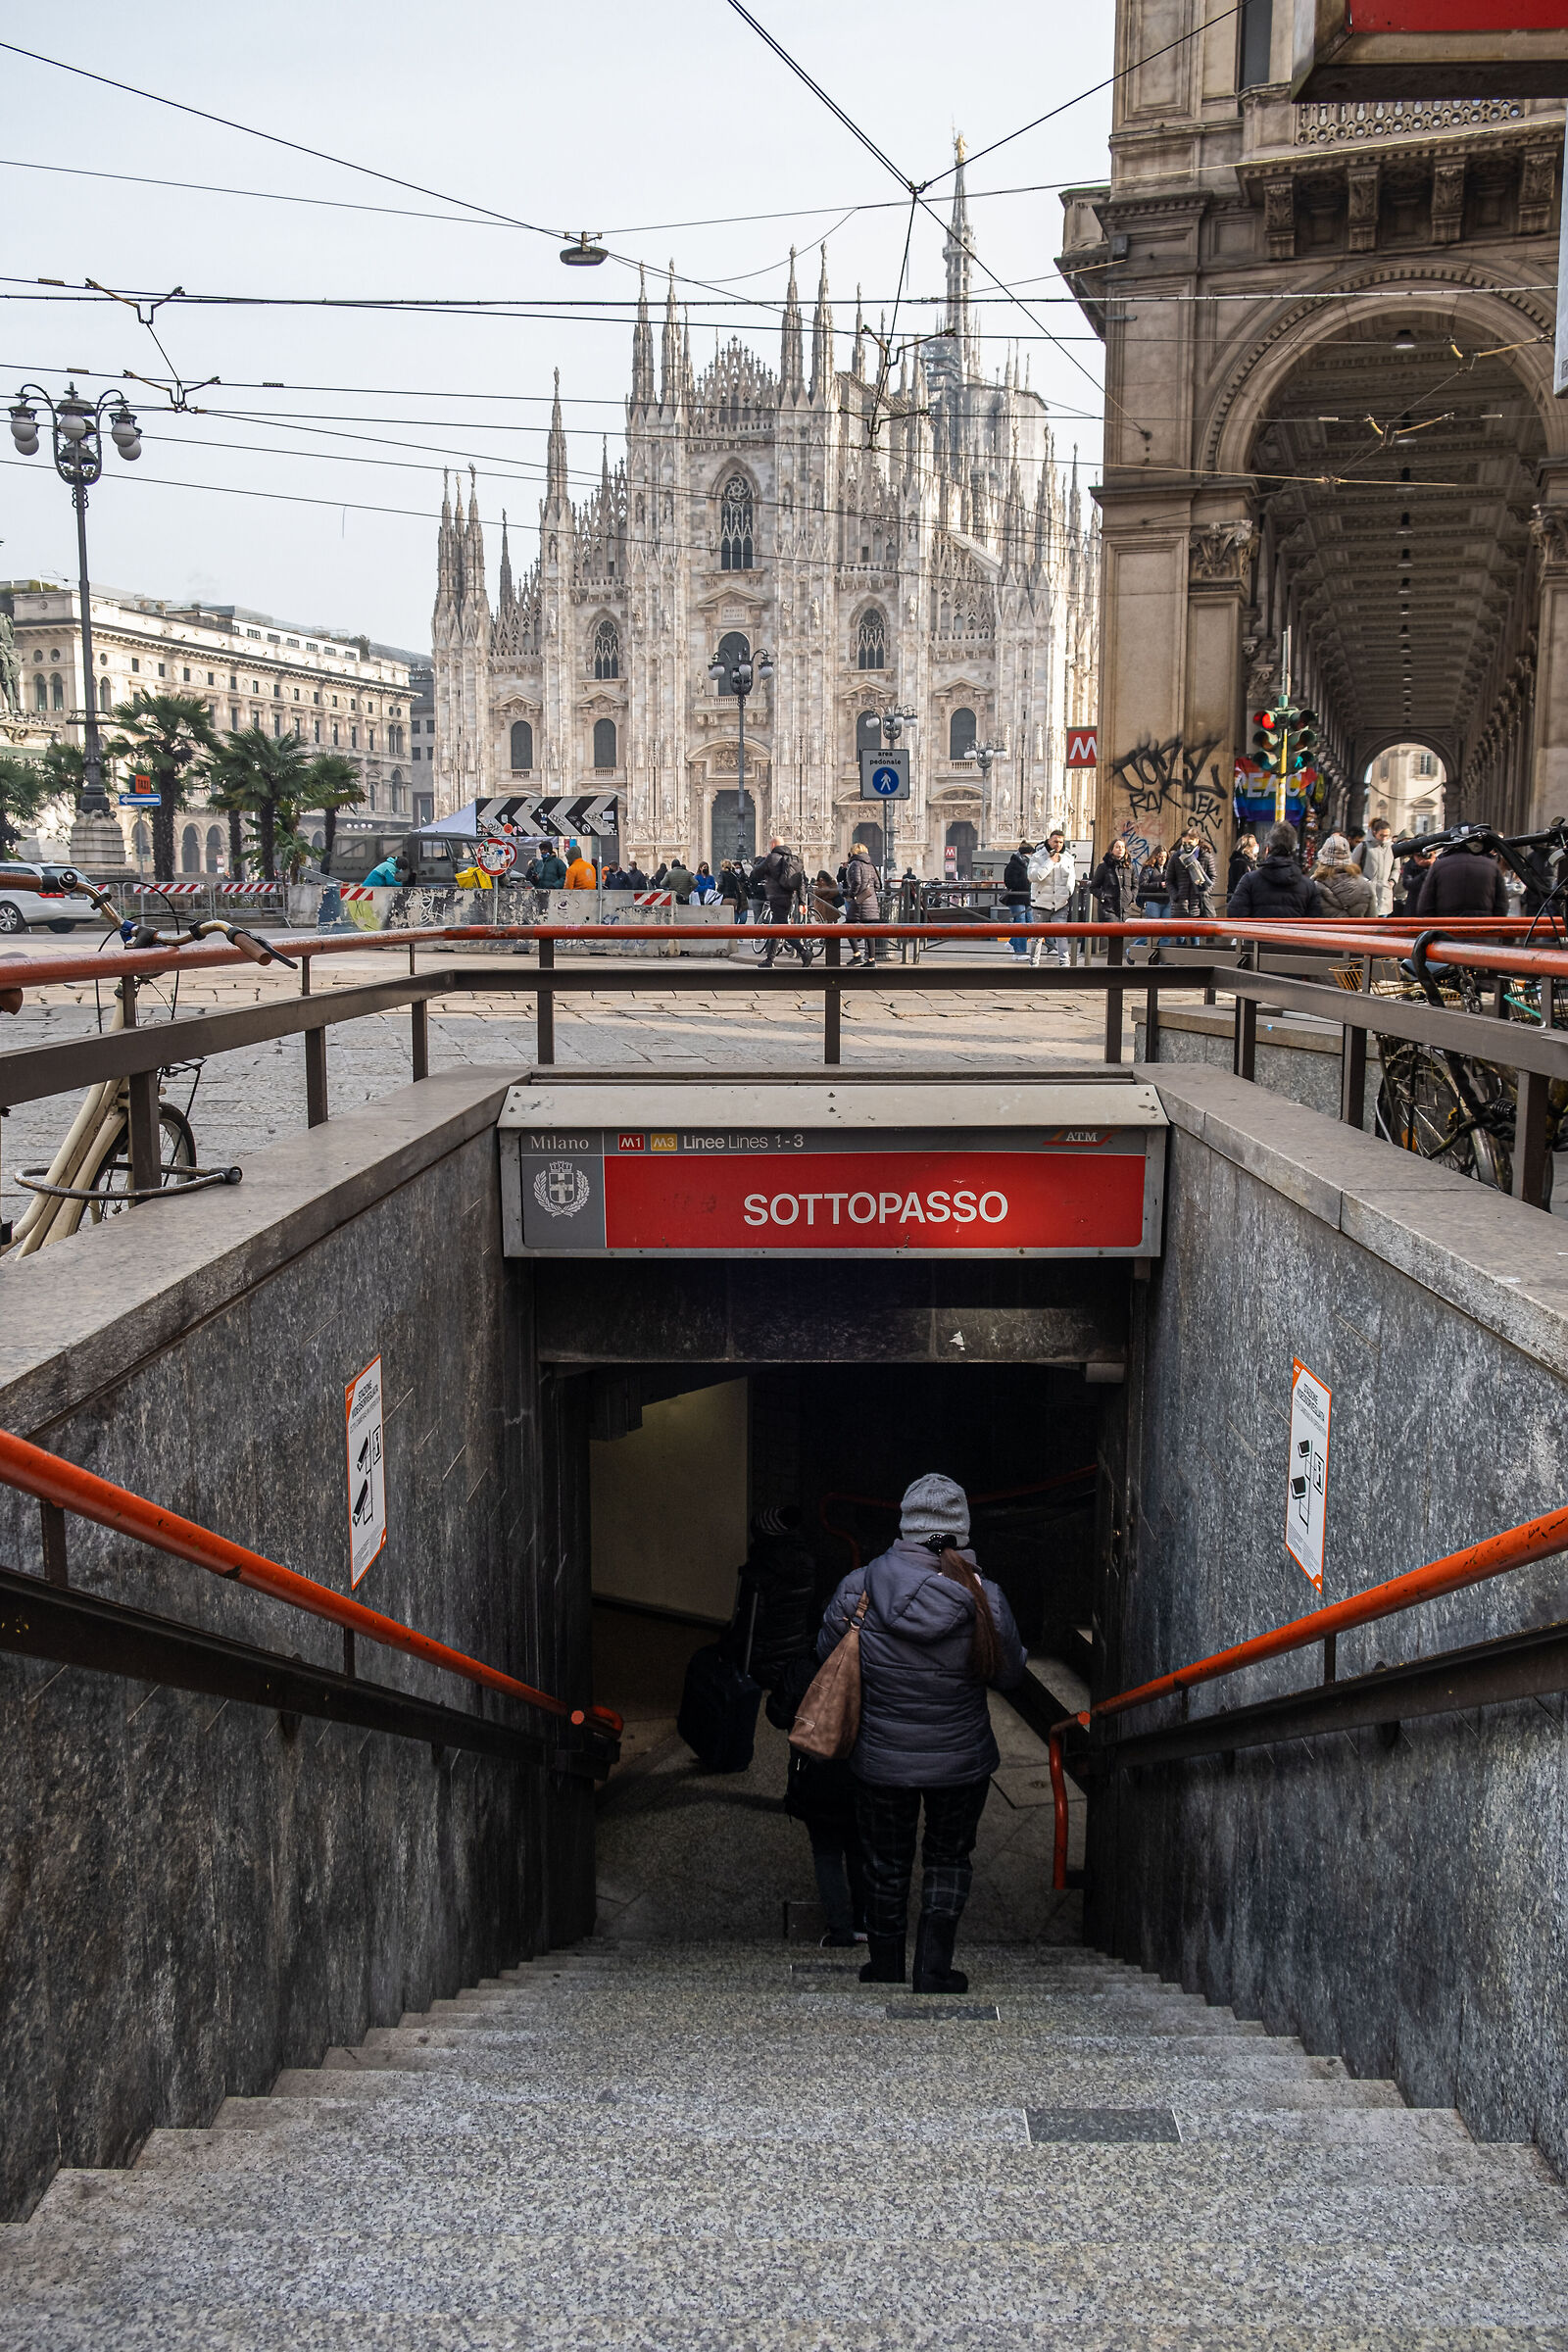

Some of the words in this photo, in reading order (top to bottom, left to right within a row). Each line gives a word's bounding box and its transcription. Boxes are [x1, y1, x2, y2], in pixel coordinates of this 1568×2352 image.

[1069, 736, 1098, 760] M
[137, 778, 149, 790] TAXI
[529, 1134, 589, 1151] Milano
[620, 1136, 642, 1148] M1
[653, 1136, 675, 1149] M3
[683, 1134, 725, 1150] Linee
[728, 1134, 768, 1150] Lines
[1065, 1131, 1099, 1143] ATM
[743, 1190, 1009, 1227] SOTTOPASSO
